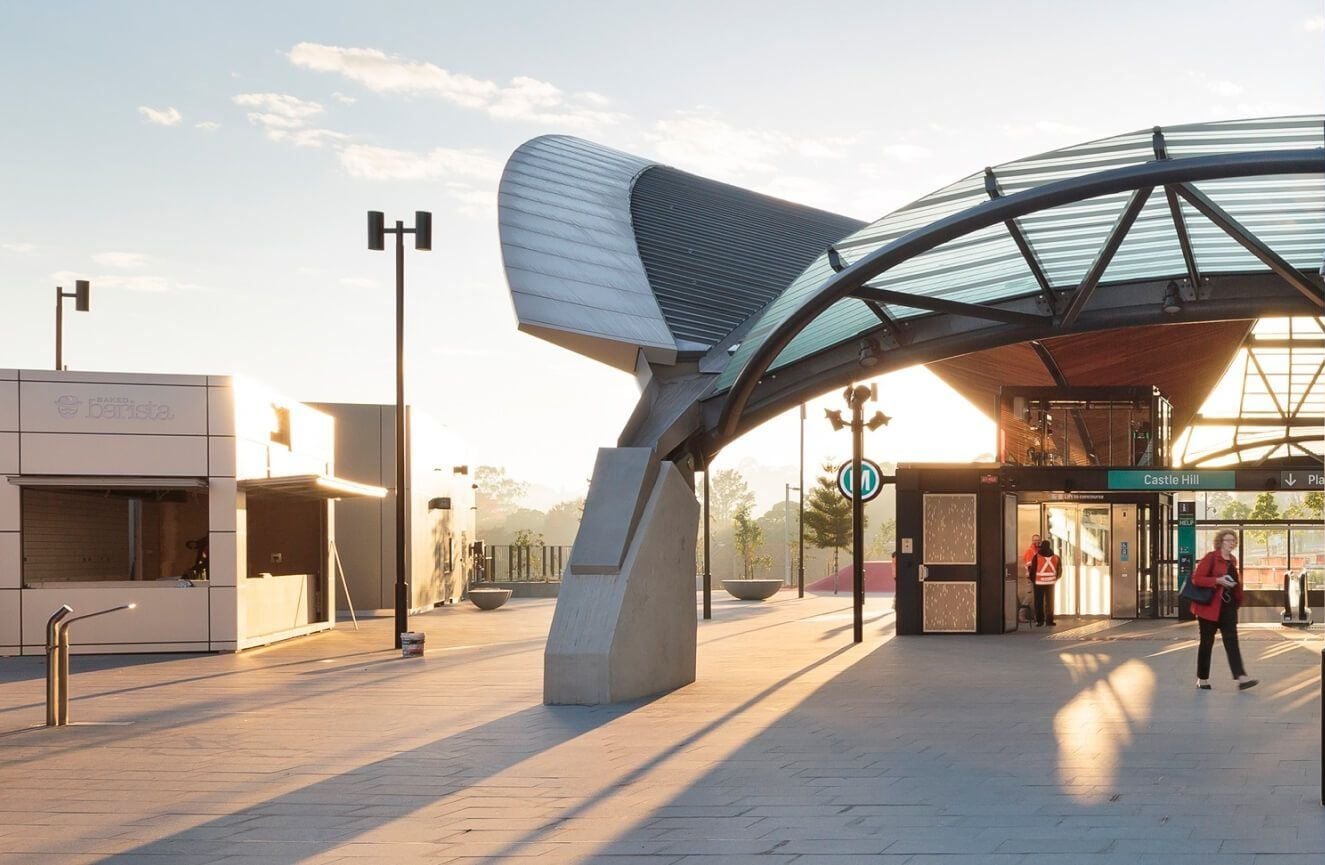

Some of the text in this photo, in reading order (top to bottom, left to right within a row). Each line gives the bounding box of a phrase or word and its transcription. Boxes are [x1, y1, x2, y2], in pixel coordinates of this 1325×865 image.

[85, 398, 175, 420] barista
[1144, 474, 1199, 485] Castle Hill
